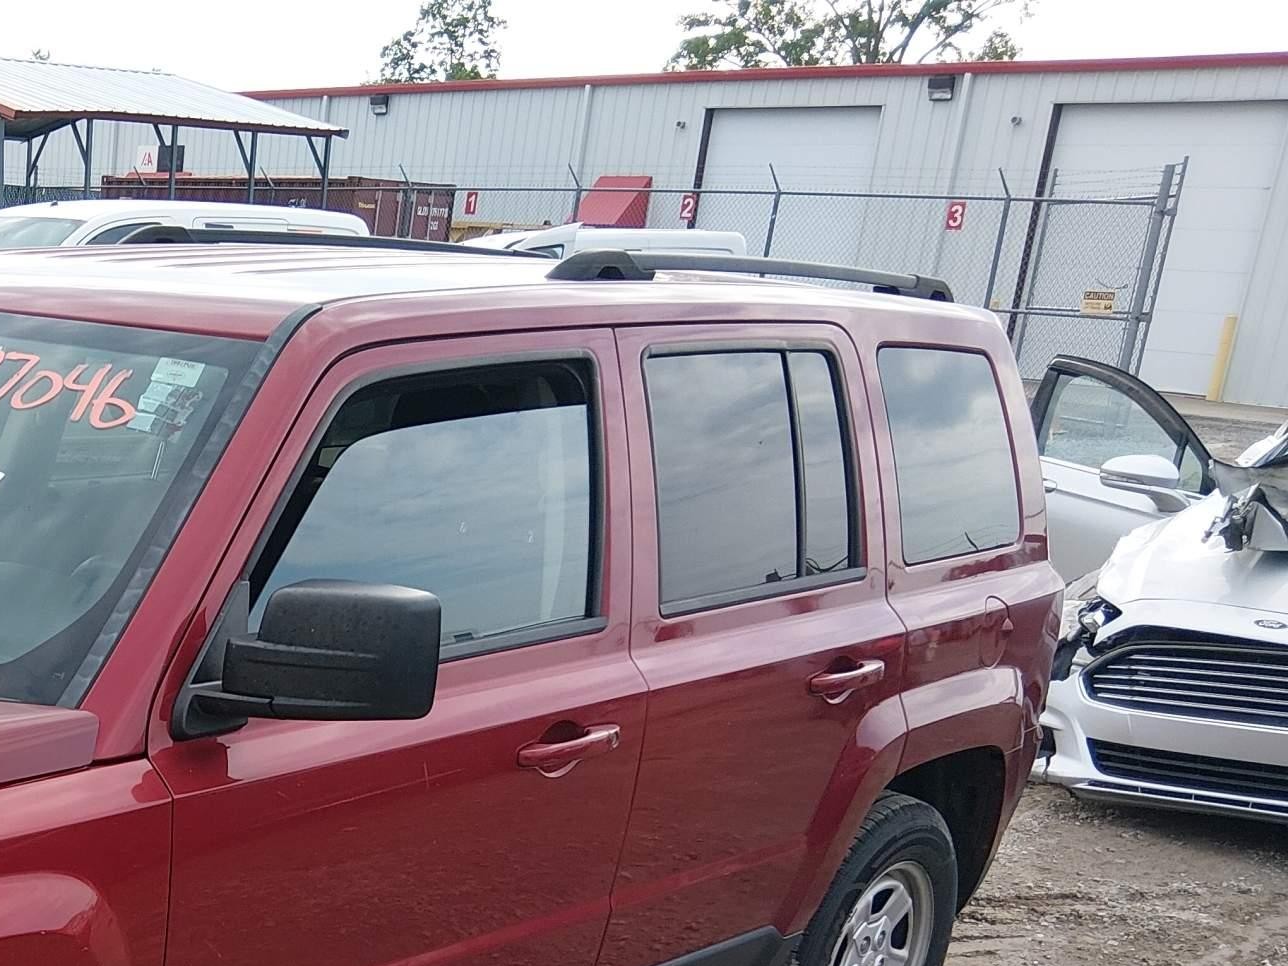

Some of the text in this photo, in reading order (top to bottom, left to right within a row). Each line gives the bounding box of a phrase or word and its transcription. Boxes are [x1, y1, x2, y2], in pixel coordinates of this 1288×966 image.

[468, 194, 476, 213] 1
[681, 197, 694, 218] 2
[948, 204, 963, 227] 3
[1084, 292, 1114, 301] CAUTION
